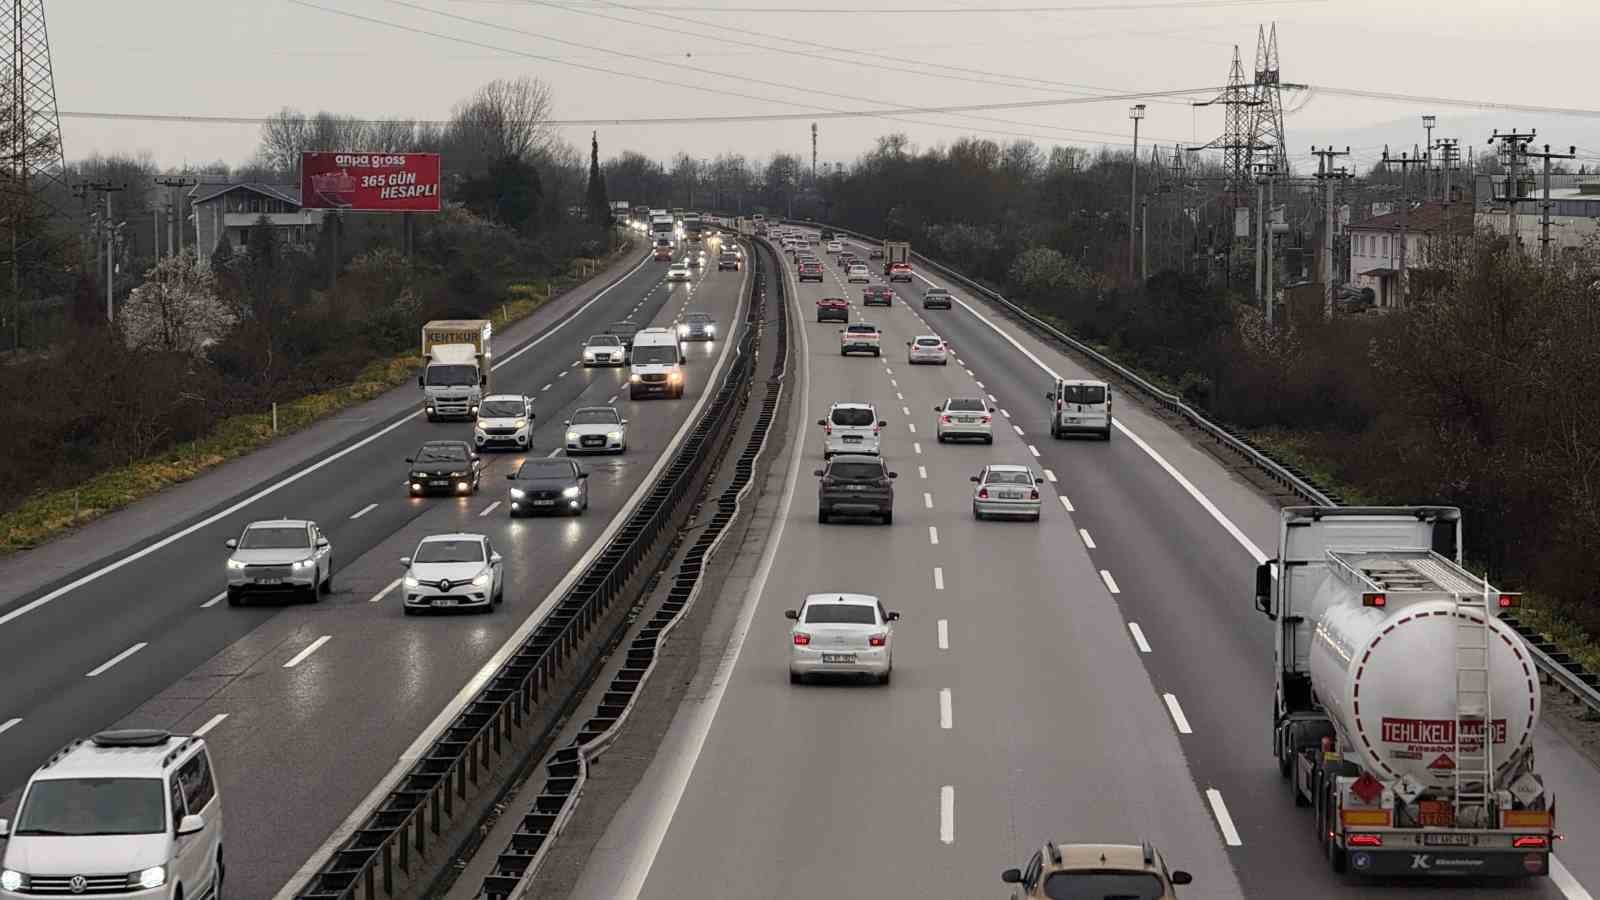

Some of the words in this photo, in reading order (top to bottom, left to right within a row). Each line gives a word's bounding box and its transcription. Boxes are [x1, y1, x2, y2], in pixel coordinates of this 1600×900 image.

[335, 154, 369, 167] anpa
[371, 154, 406, 168] gross
[361, 175, 386, 188] 365
[388, 171, 416, 186] GÜN
[380, 183, 437, 199] HESAPLI
[1383, 721, 1453, 743] TEHLİKELİ
